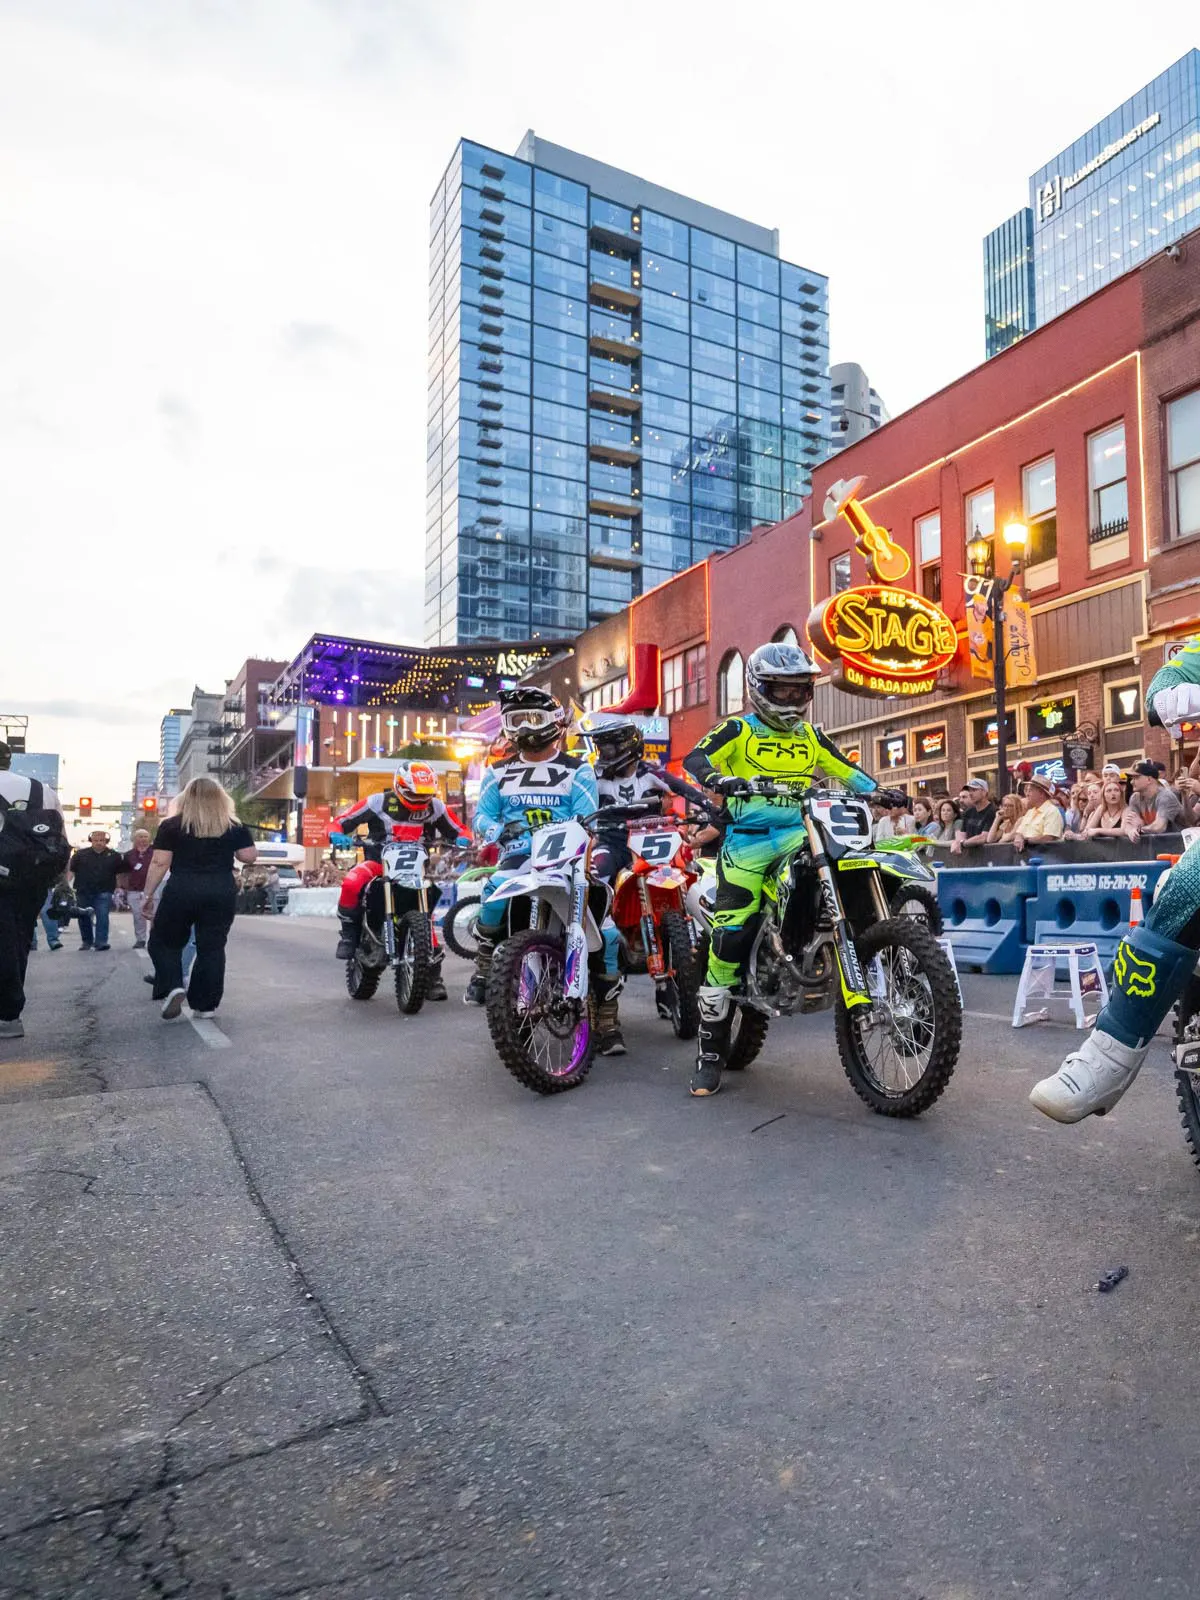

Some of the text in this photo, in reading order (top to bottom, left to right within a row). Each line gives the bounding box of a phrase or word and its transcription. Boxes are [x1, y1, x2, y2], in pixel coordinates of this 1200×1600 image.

[881, 590, 906, 607] THE
[835, 594, 957, 656] STAGE
[847, 668, 935, 694] ON BROADWAY
[498, 766, 571, 790] FLY
[520, 794, 561, 806] YAMAHA
[829, 804, 870, 836] 9
[536, 831, 567, 862] 4
[640, 833, 673, 860] 5
[394, 850, 419, 871] 2
[846, 939, 866, 990] DUNLOP
